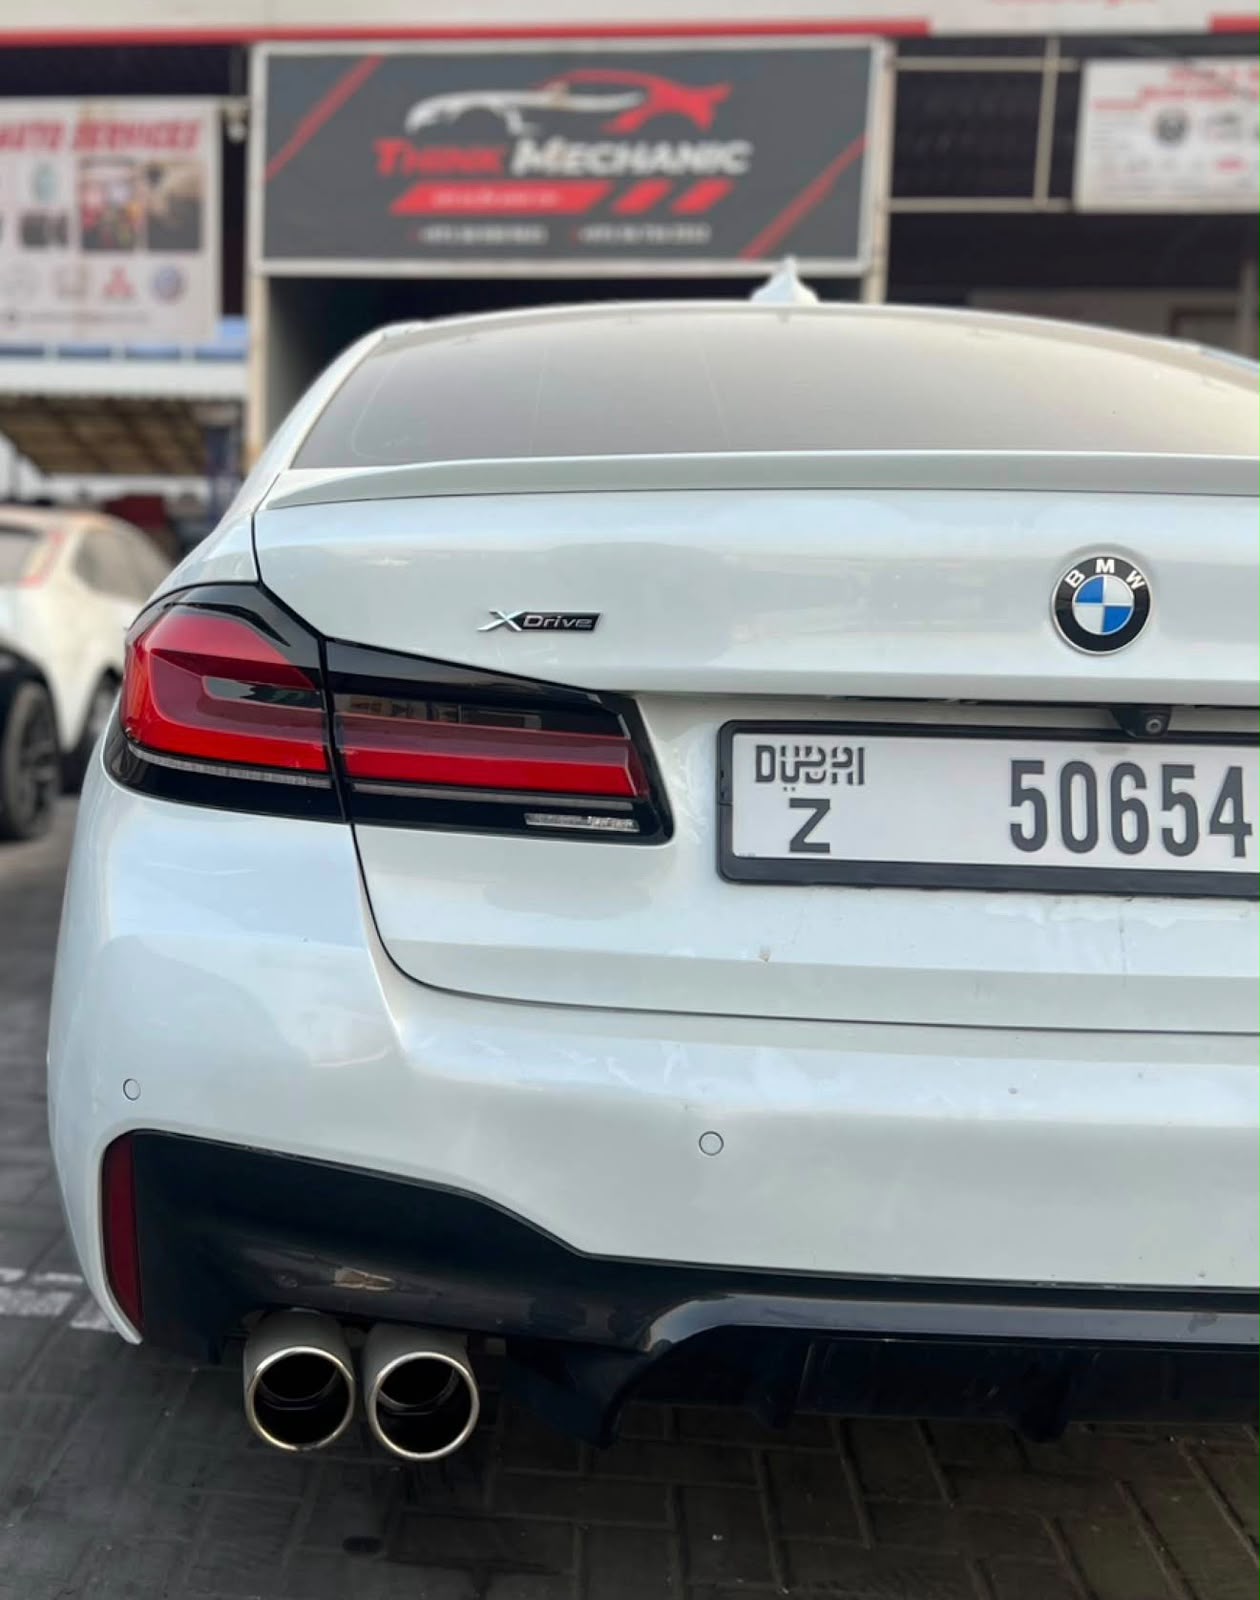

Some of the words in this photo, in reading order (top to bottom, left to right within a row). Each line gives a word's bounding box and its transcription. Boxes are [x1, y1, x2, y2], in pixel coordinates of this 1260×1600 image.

[510, 136, 754, 177] MECHANIC
[1064, 558, 1146, 590] BMW
[788, 797, 831, 854] Z
[1009, 758, 1254, 858] 50654
